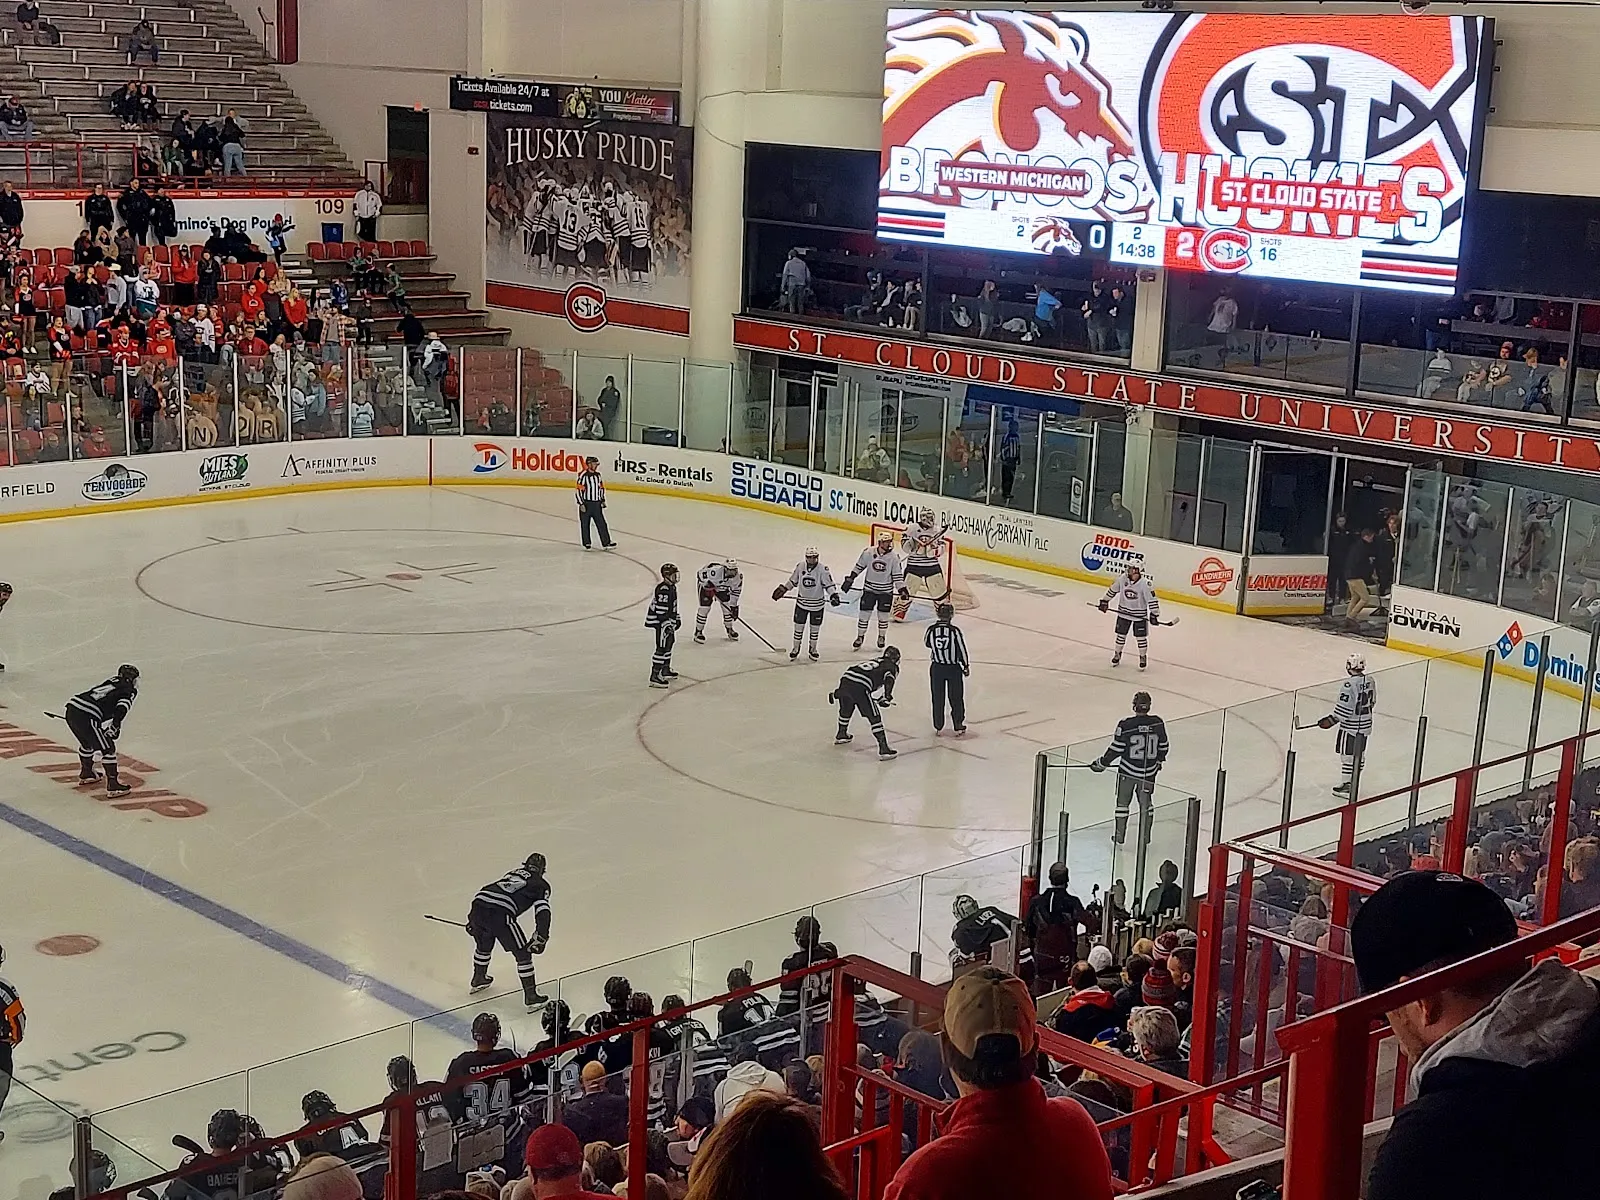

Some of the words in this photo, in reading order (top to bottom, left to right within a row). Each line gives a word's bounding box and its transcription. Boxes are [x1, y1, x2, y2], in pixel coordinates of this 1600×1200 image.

[457, 80, 483, 93] Tickets
[485, 82, 517, 95] Available
[518, 84, 540, 98] 24/7
[541, 88, 550, 97] at
[599, 90, 621, 103] YOU
[506, 127, 588, 167] HUSKY
[597, 131, 675, 181] PRIDE
[940, 166, 1004, 185] WESTERN
[1010, 170, 1084, 191] MICHIGAN
[1221, 181, 1248, 203] ST.
[1251, 184, 1316, 207] CLOUD
[1319, 188, 1382, 213] STATE
[314, 199, 345, 215] 109
[251, 214, 292, 231] Poud
[1016, 225, 1025, 237] 2
[1089, 224, 1106, 249] 0
[1133, 226, 1142, 240] 2
[1118, 242, 1156, 258] 14:38
[1175, 231, 1196, 259] 2
[1259, 247, 1277, 261] 16
[788, 328, 842, 359] ST.
[876, 342, 1017, 383] CLOUD
[1053, 366, 1197, 411] STATE
[203, 455, 238, 472] MIES
[305, 457, 348, 470] AFFINITY
[352, 456, 377, 466] PLUS
[203, 469, 238, 484] OUTLAND
[658, 463, 713, 482] Rentals
[732, 461, 759, 480] ST.
[762, 467, 823, 492] CLOUD
[731, 477, 822, 512] SUBARU
[829, 489, 844, 511] SC
[846, 491, 878, 518] Times
[997, 523, 1033, 548] BRYANT
[1094, 533, 1135, 550] ROTO-
[1195, 569, 1233, 582] LANDWEHR
[658, 593, 669, 603] 22
[1393, 604, 1461, 627] ENTRAL
[935, 637, 950, 650] 67
[1129, 733, 1160, 760] 20
[463, 1079, 511, 1122] 34
